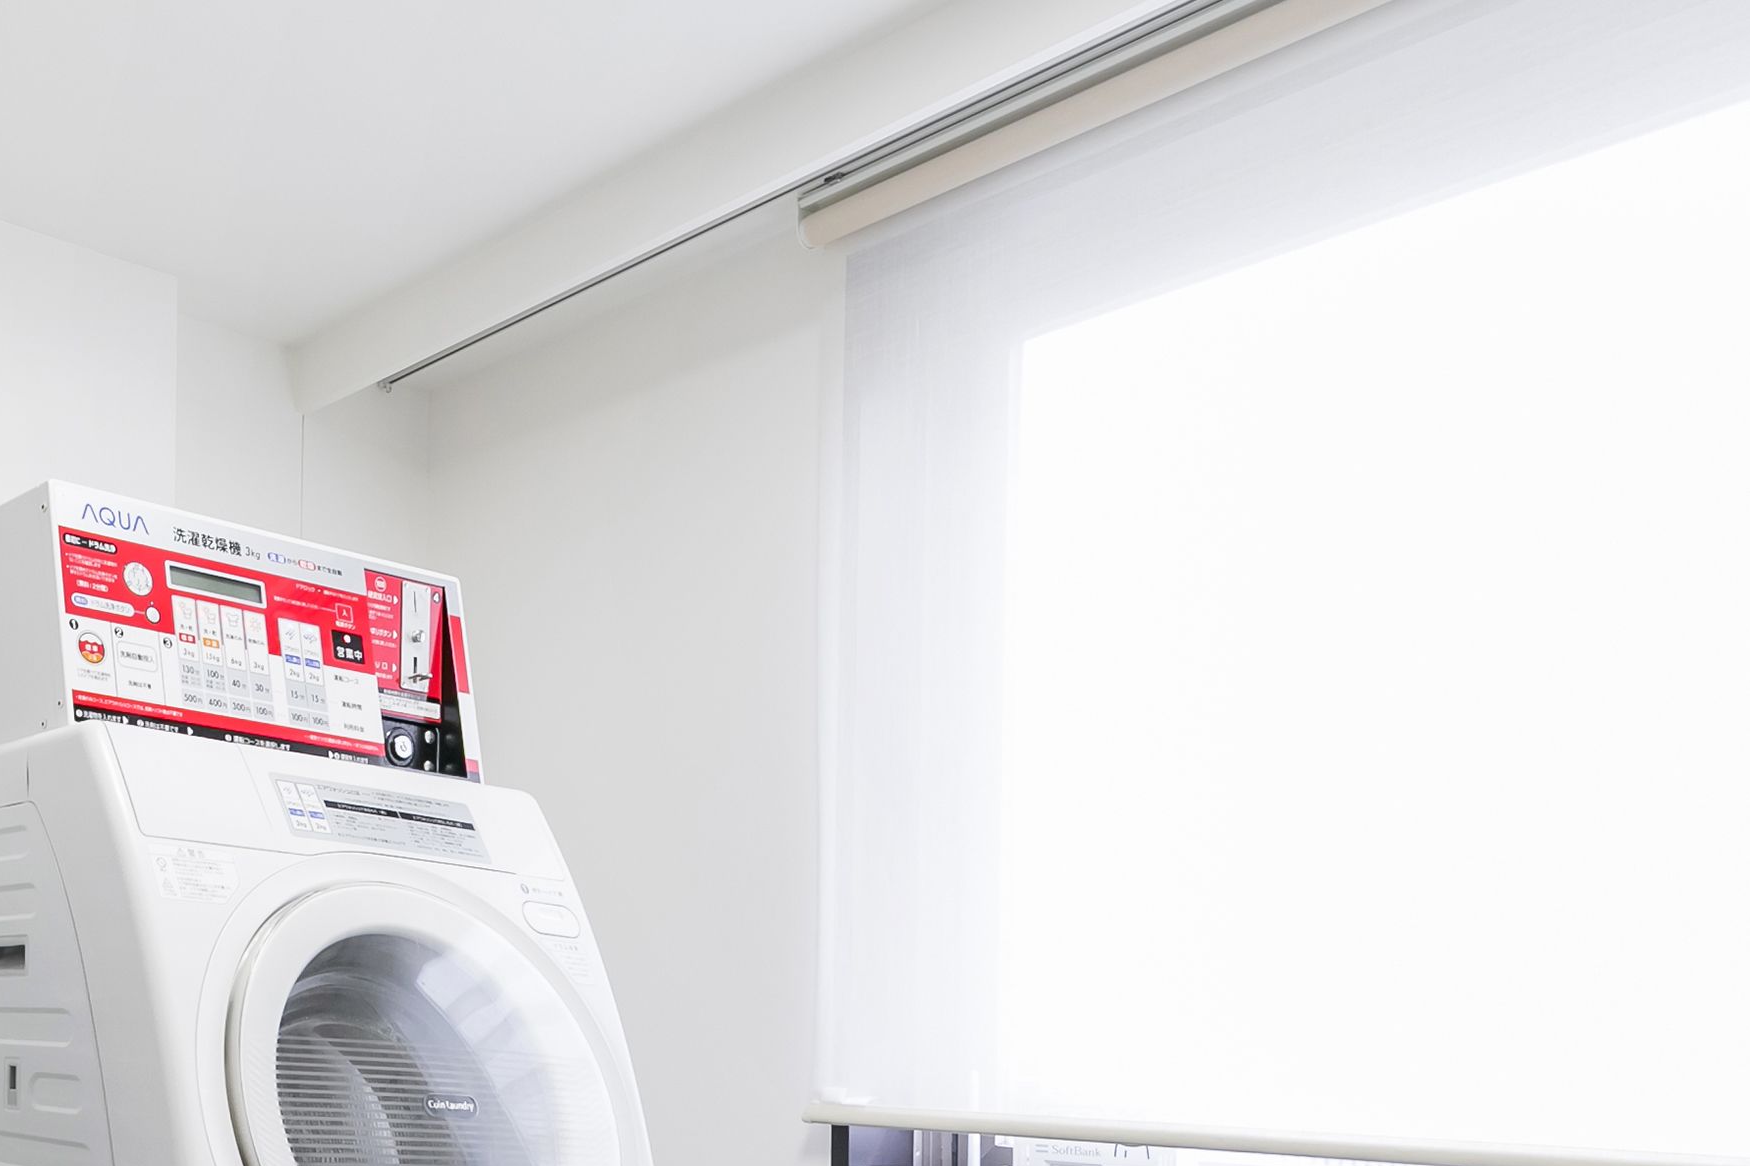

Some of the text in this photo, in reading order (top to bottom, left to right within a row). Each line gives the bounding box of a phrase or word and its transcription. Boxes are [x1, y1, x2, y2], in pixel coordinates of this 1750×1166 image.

[82, 503, 149, 535] AQUA
[172, 527, 261, 560] 洗濯乾燥機 3kg
[336, 645, 363, 662] 営業中
[1052, 1145, 1100, 1157] SoftBank
